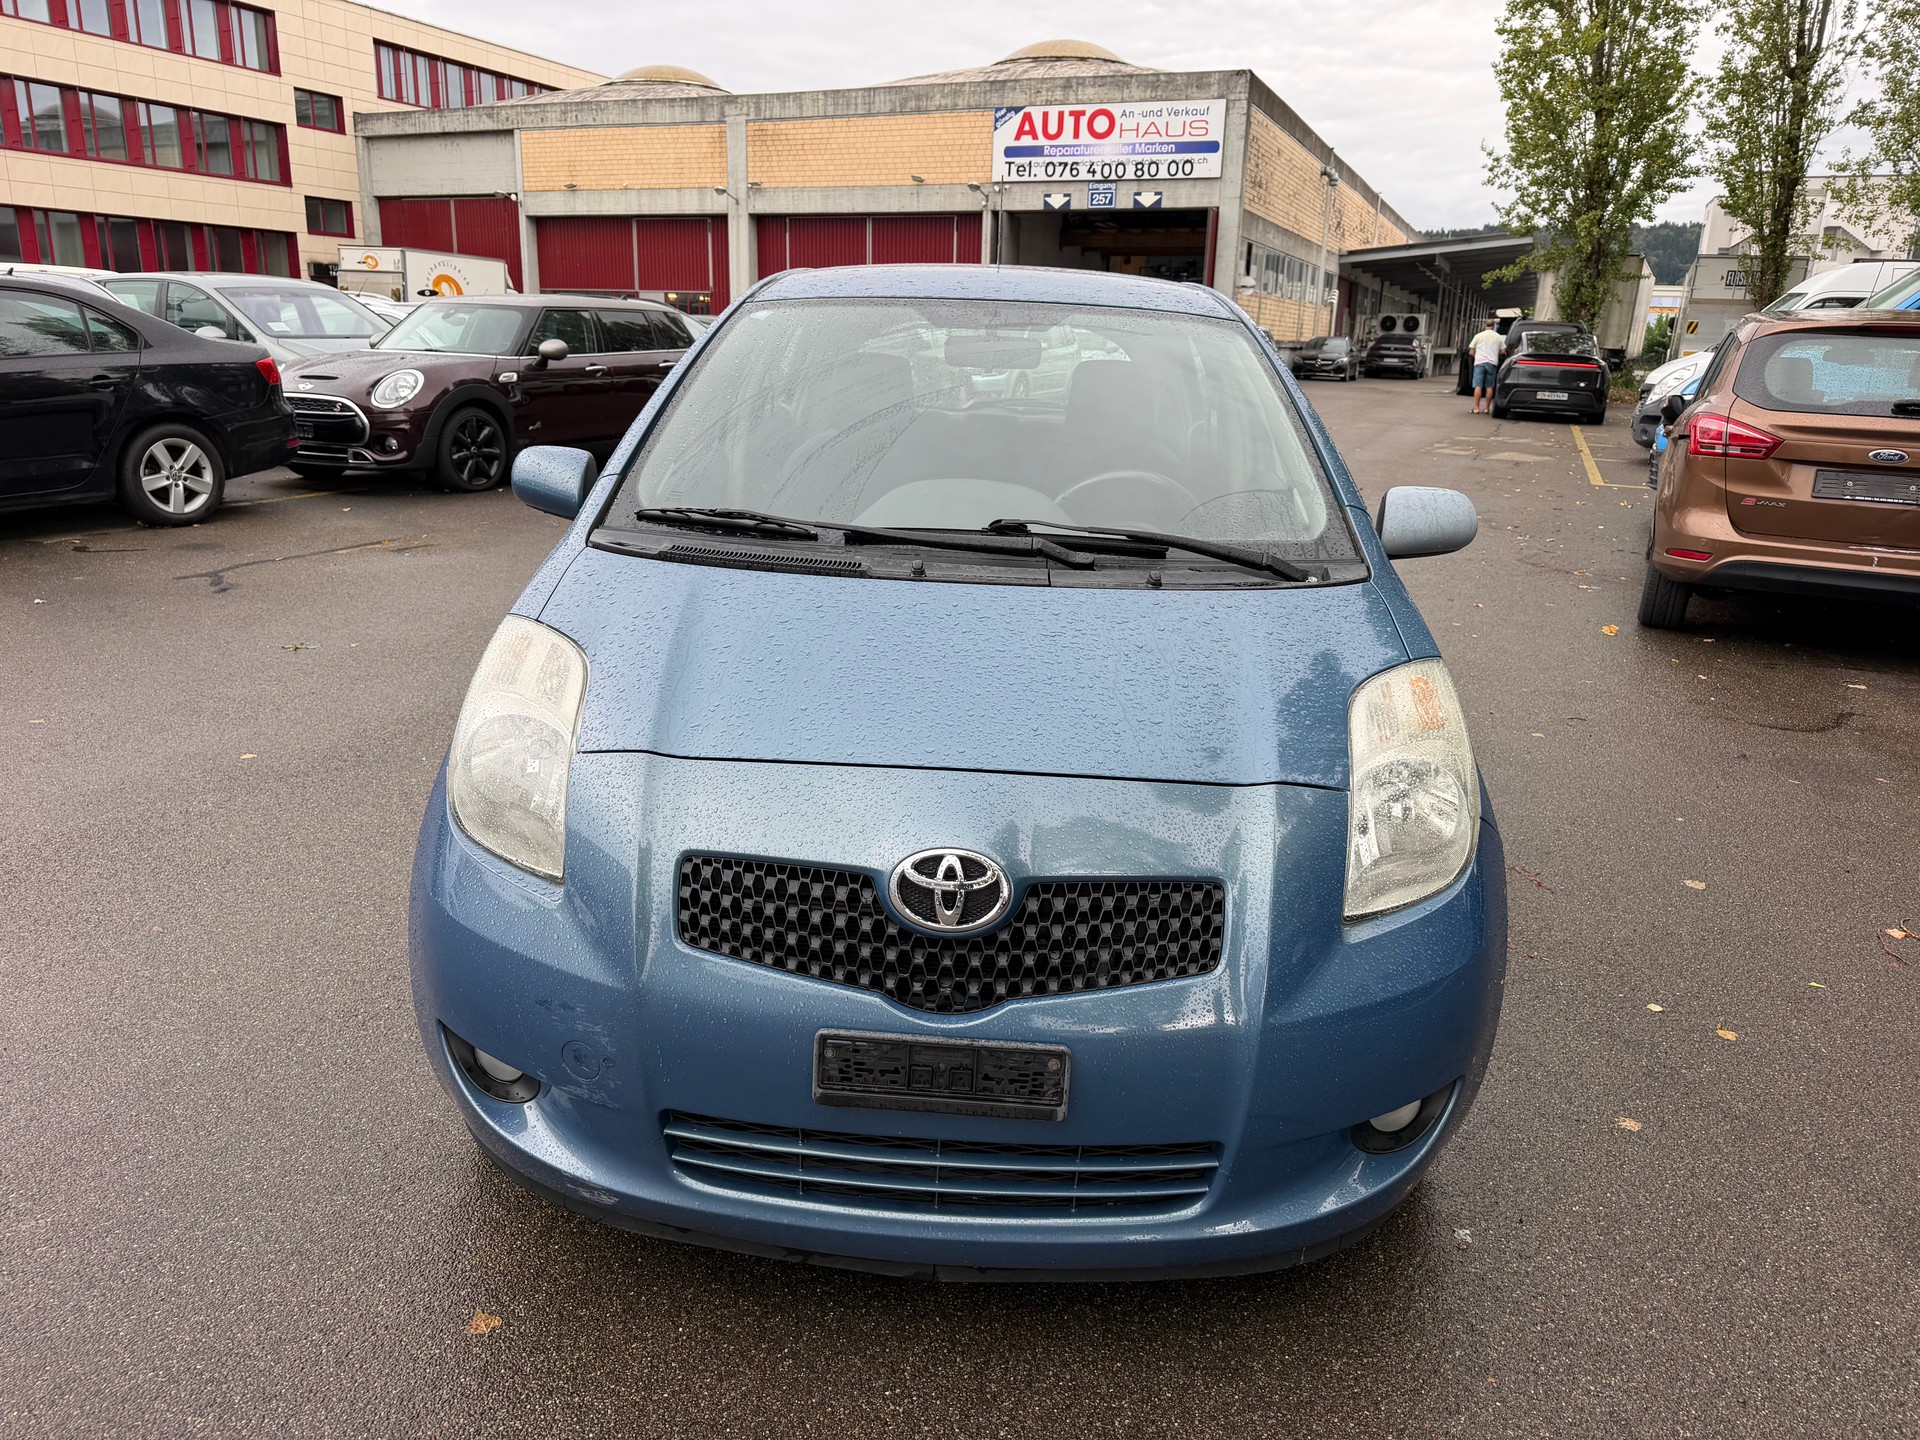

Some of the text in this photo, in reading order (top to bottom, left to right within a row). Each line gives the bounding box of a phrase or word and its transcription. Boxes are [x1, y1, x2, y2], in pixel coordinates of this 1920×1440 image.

[1120, 109, 1135, 118] An
[1166, 106, 1210, 117] Verkauf
[1014, 108, 1116, 141] AUTO
[1119, 119, 1209, 139] HAUS
[1135, 143, 1176, 154] Marken
[1005, 160, 1194, 179] Tel. 076 400 80 00
[1089, 182, 1117, 190] Eingang
[1092, 193, 1112, 205] 257
